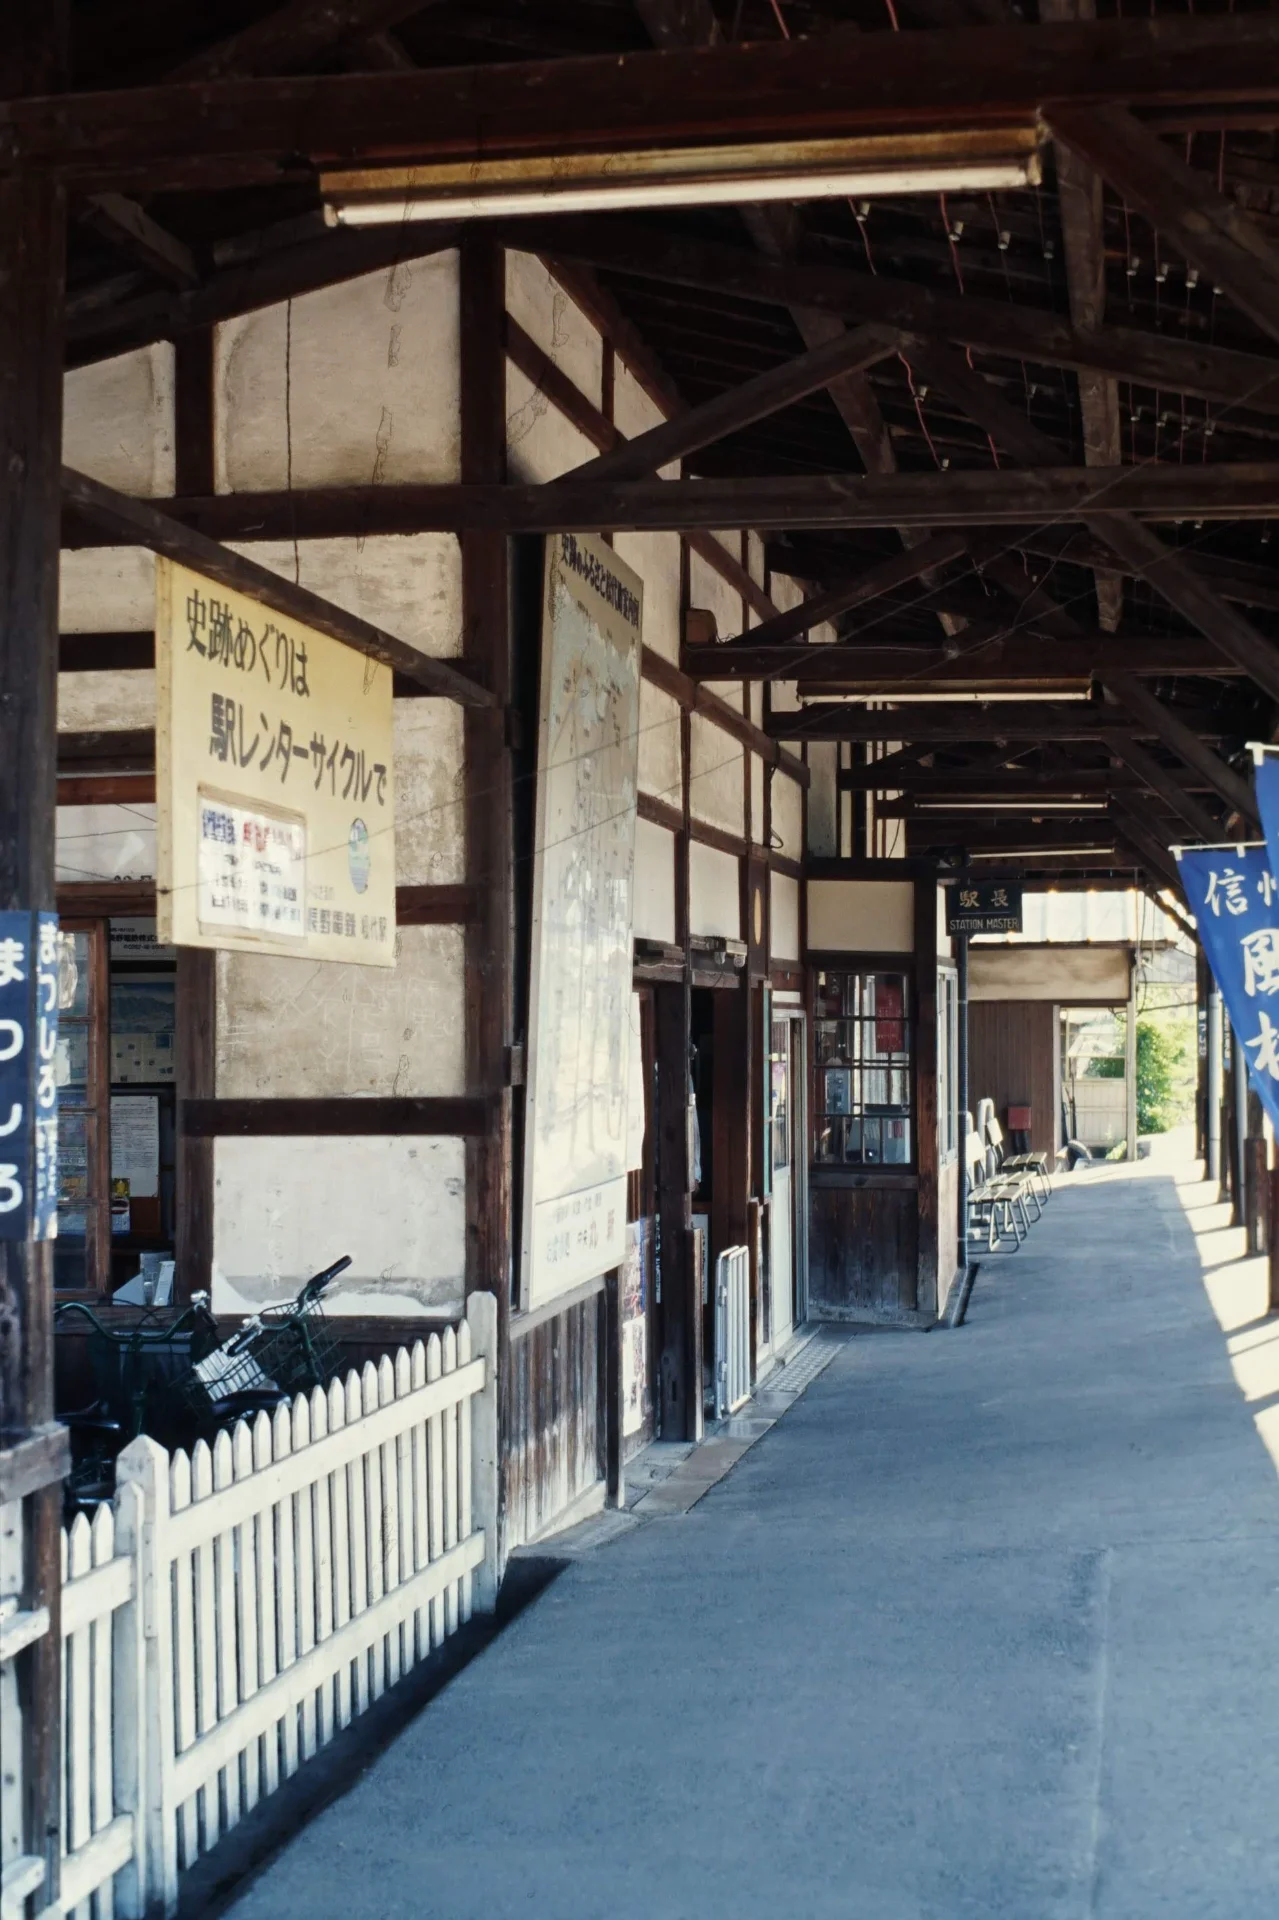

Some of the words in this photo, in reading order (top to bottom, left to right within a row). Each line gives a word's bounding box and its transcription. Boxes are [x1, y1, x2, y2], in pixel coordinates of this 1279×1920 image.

[186, 589, 310, 698] 史跡めぐりは
[950, 919, 984, 931] STATION
[986, 918, 1019, 929] MASTER
[38, 921, 57, 1108] まつしろ
